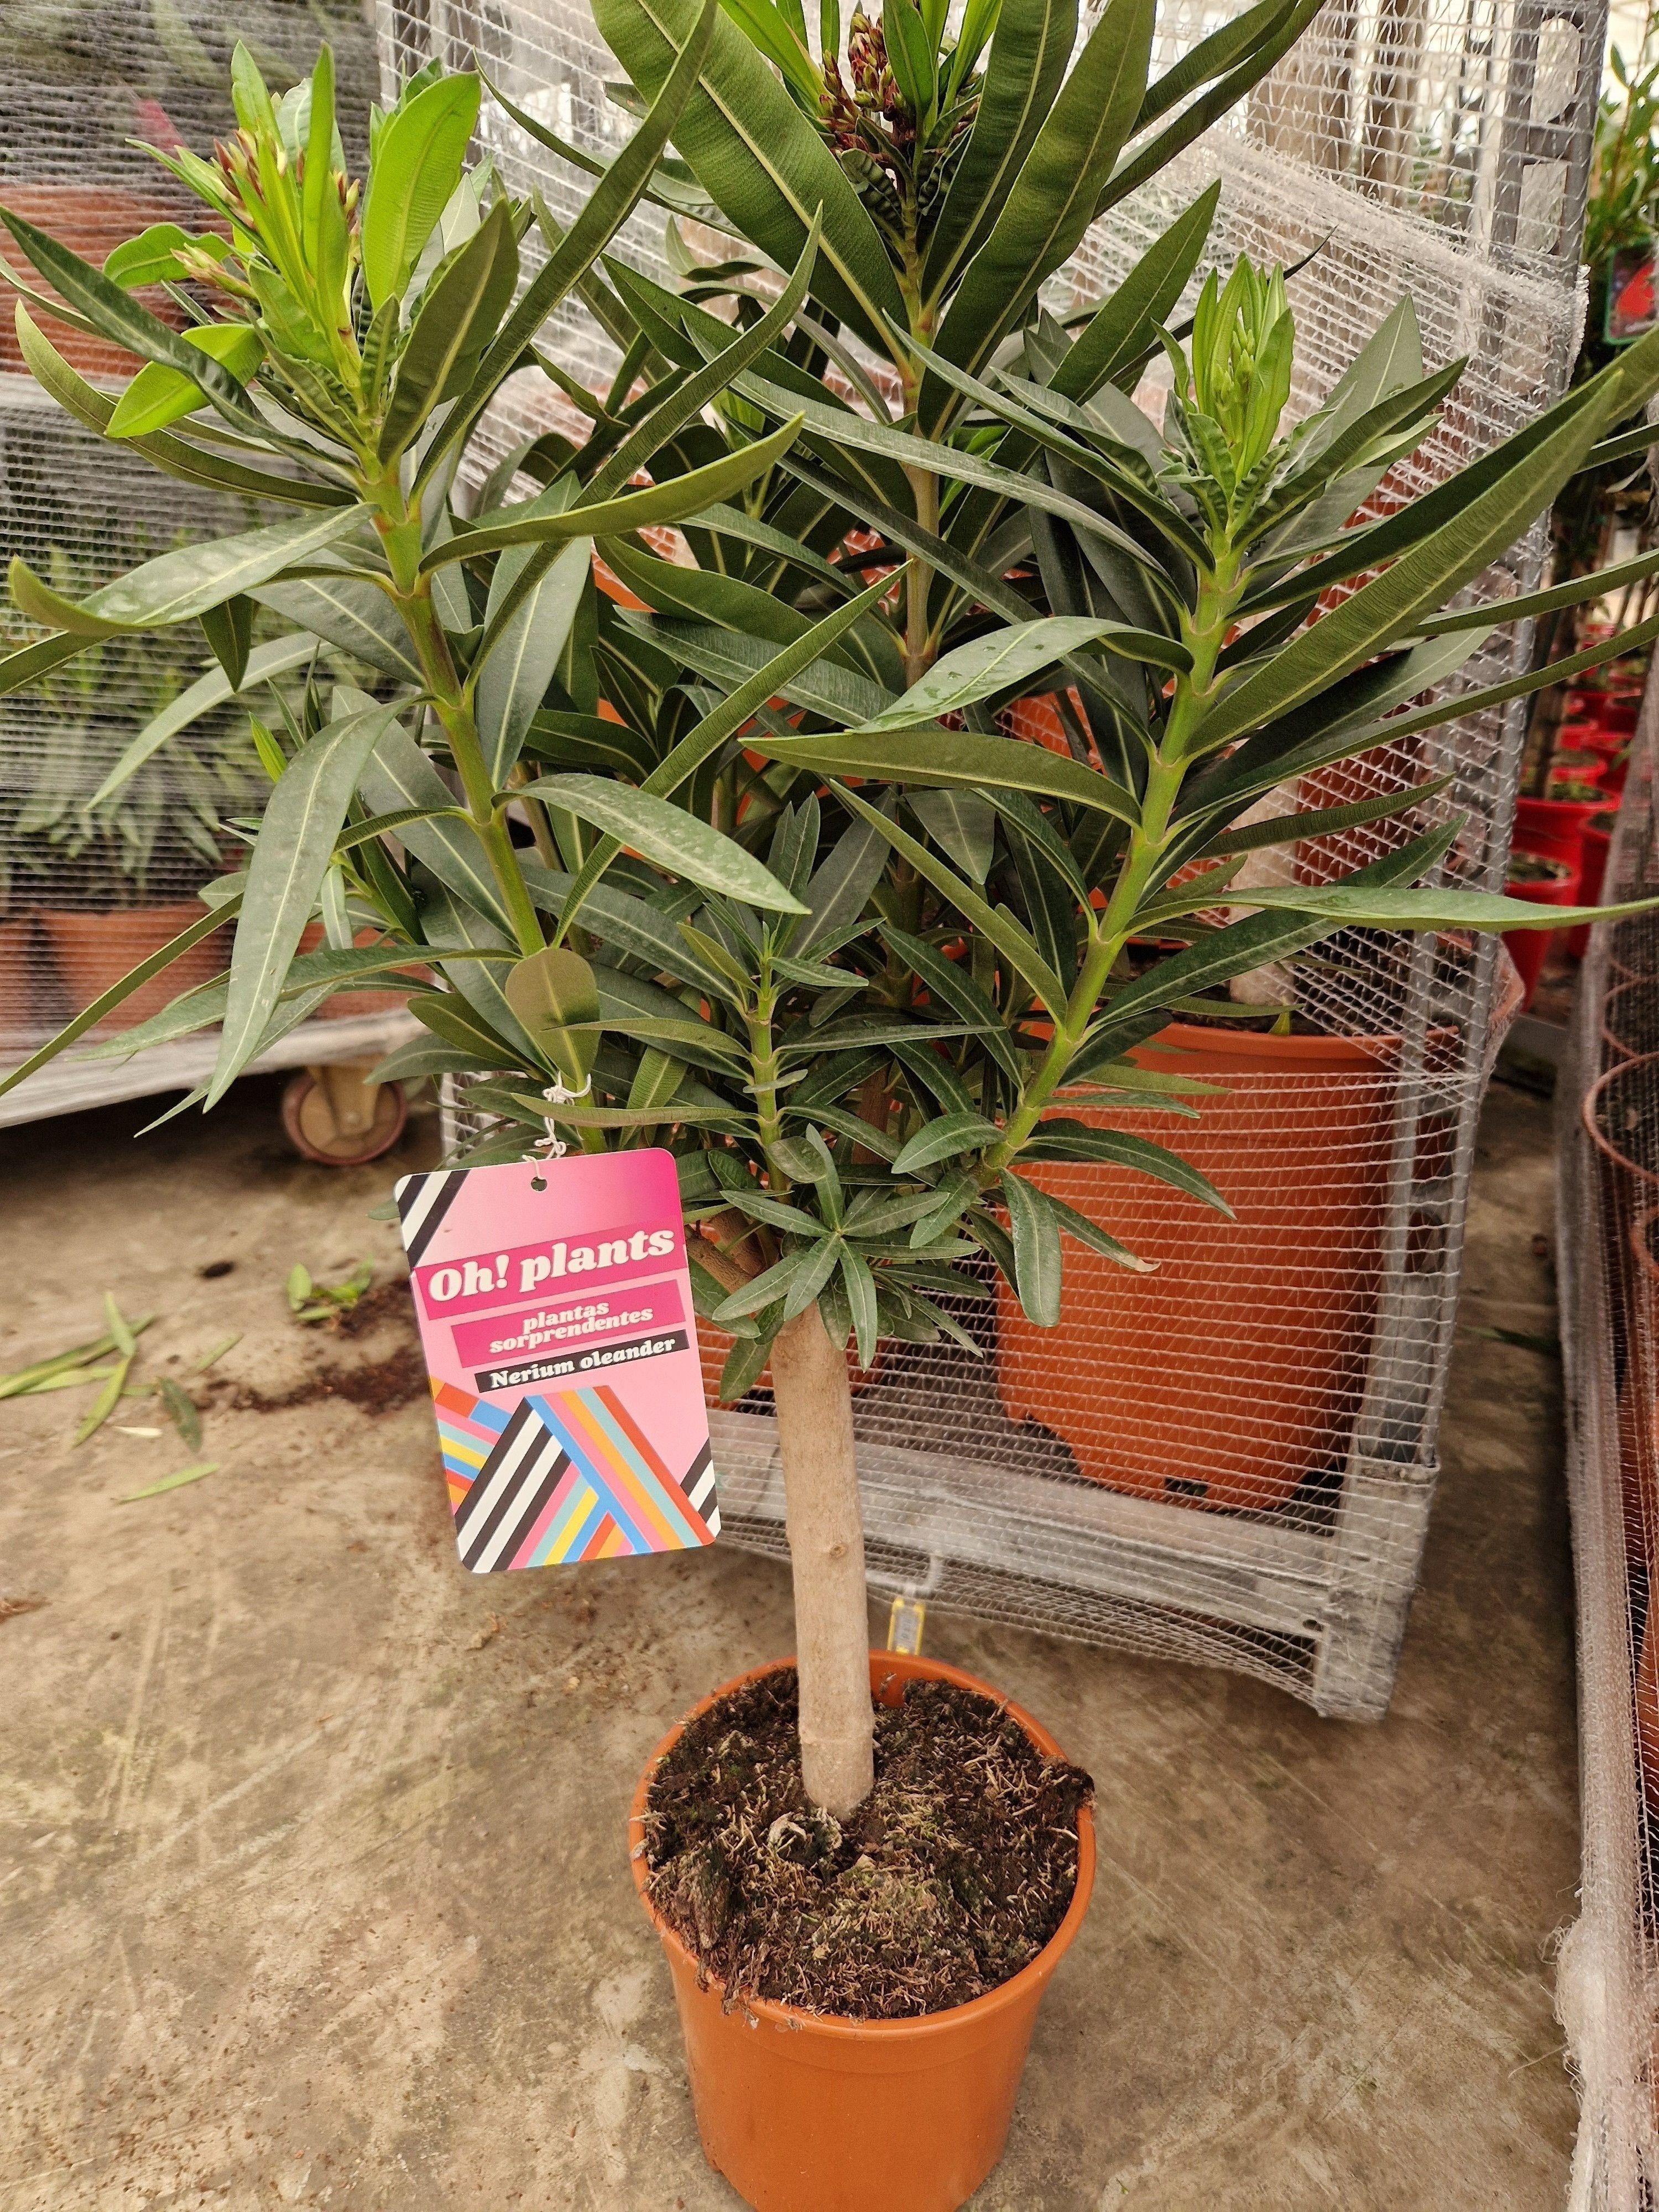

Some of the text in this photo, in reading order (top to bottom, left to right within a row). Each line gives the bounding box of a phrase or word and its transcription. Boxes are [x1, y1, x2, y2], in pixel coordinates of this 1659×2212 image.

[429, 1229, 675, 1301] Oh! plants
[490, 1307, 653, 1353] sorprendentes
[523, 1302, 609, 1334] plantas
[490, 1338, 676, 1388] Nerium oleander
